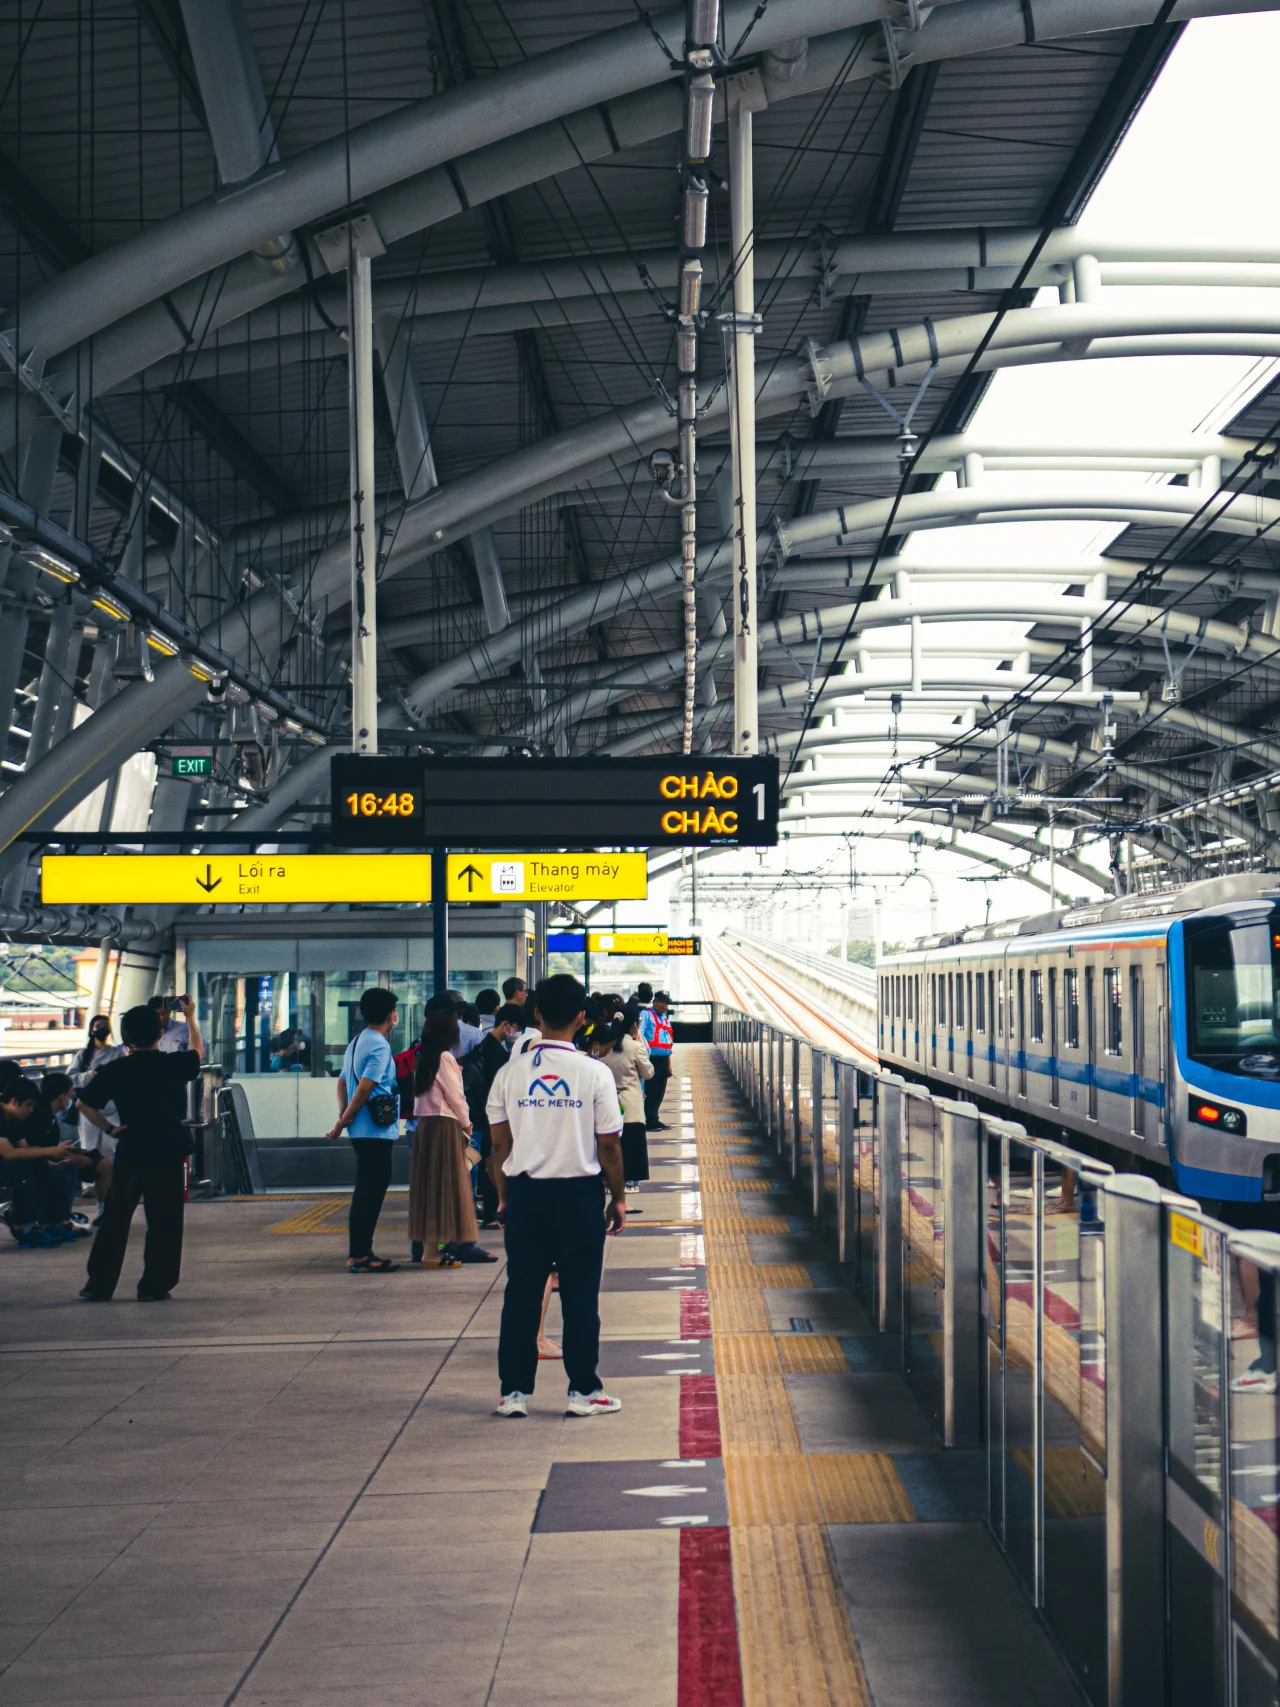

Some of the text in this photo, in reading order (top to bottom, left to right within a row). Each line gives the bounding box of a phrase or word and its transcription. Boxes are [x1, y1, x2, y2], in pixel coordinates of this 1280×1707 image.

[178, 759, 205, 773] EXIT
[346, 792, 415, 817] 16:48
[752, 783, 765, 821] 1
[238, 861, 286, 878] Lối ra
[530, 862, 619, 879] Thang máy
[238, 883, 260, 894] Exit
[530, 882, 575, 892] Elevator
[518, 1099, 583, 1108] HCMC METRO
